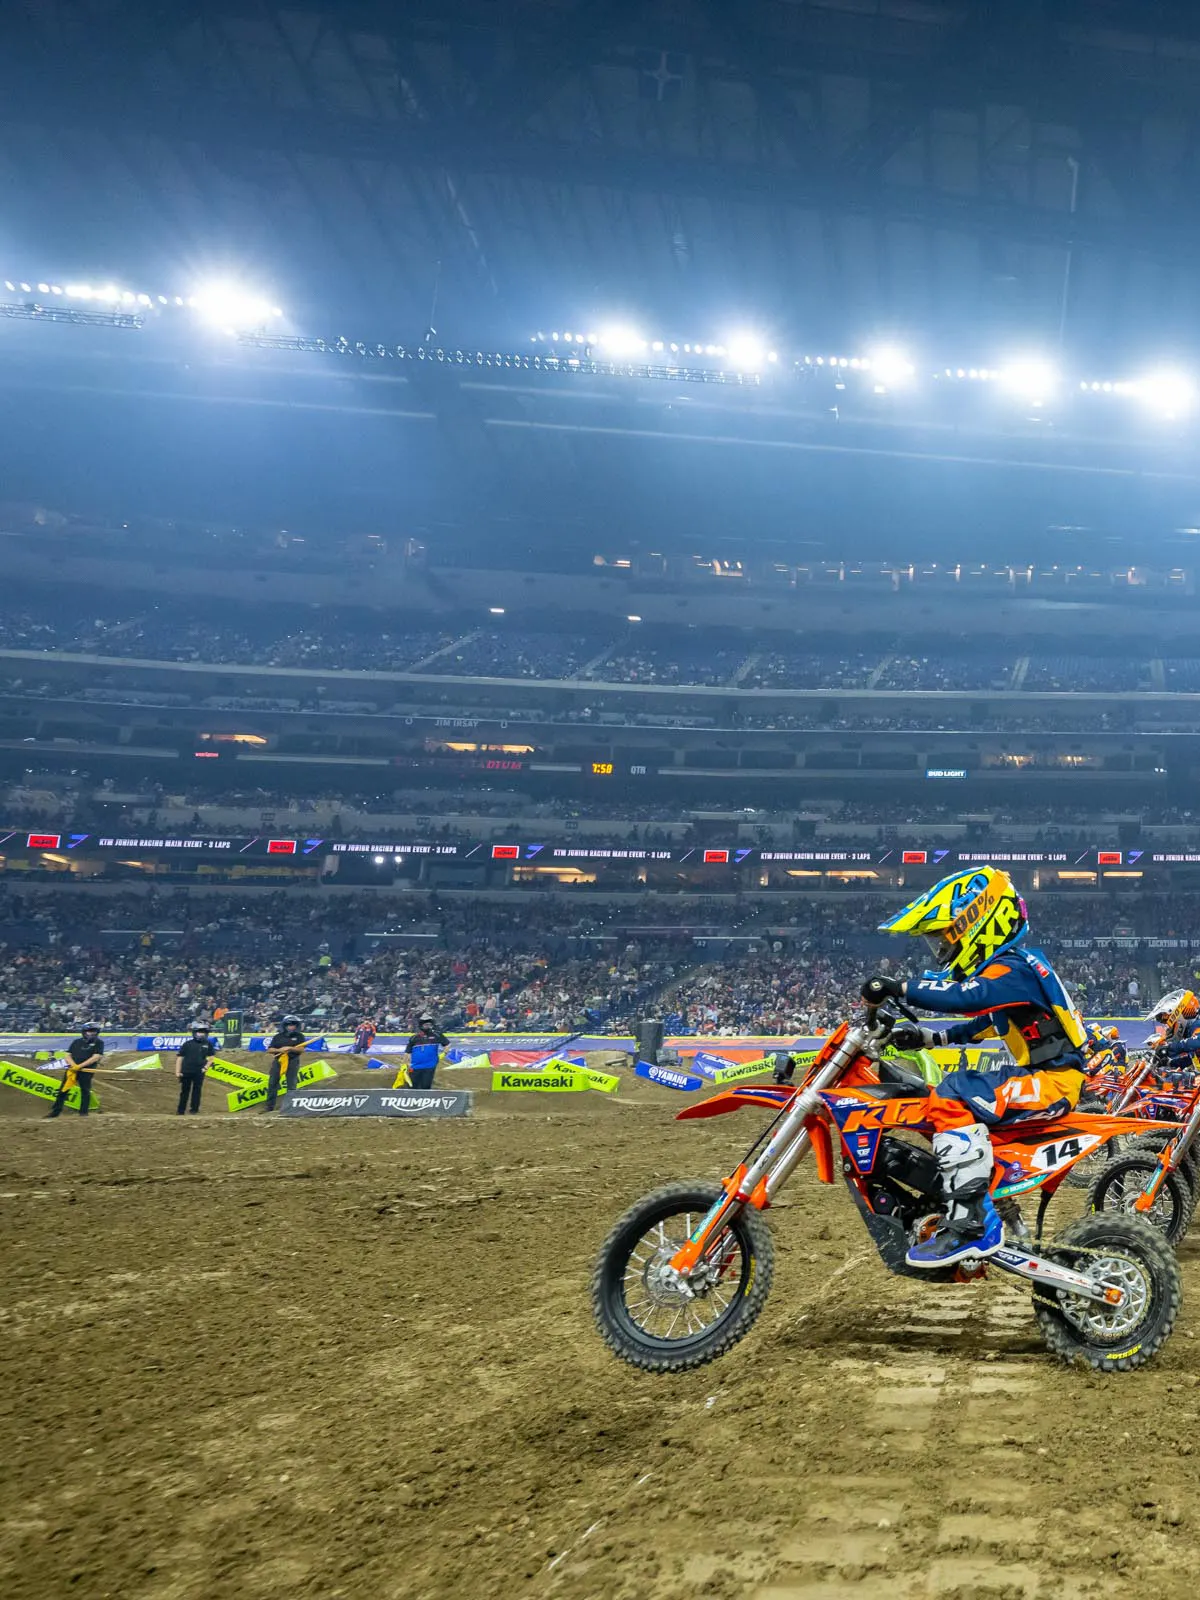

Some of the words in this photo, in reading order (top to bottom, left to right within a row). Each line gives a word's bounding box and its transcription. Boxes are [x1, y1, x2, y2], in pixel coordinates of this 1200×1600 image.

[946, 891, 994, 941] 100%
[918, 980, 954, 992] FLY
[722, 1059, 777, 1079] Kawasaki
[501, 1075, 573, 1088] Kawasaki
[658, 1069, 688, 1086] YAMAHA
[292, 1097, 352, 1110] TRIUMPH
[381, 1097, 441, 1110] TRIUMPH
[1042, 1138, 1082, 1166] 14
